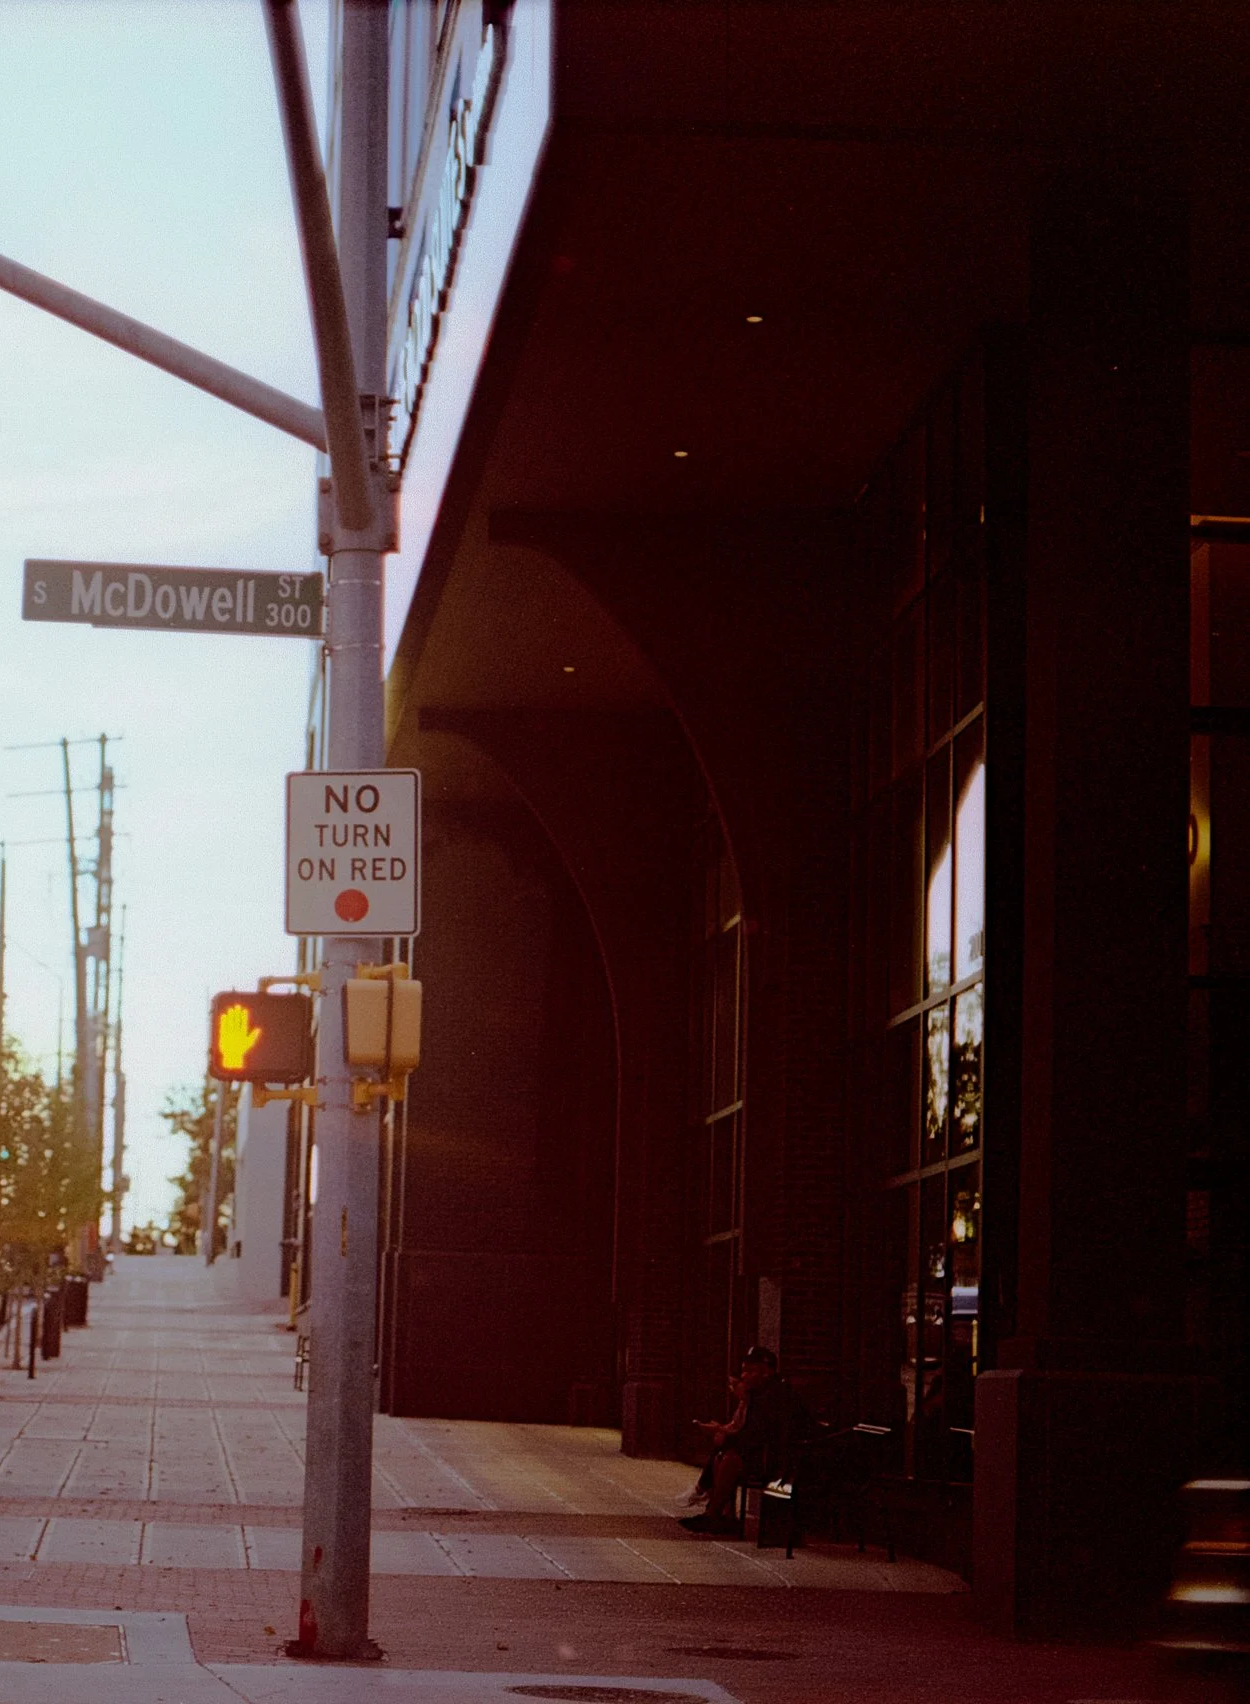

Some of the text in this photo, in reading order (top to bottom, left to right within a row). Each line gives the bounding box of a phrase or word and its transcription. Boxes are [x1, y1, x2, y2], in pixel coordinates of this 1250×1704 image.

[33, 569, 304, 624] S McDowell ST
[265, 603, 312, 629] 300
[325, 784, 380, 814] NO
[314, 823, 391, 847] TURN
[297, 857, 407, 882] ON RED
